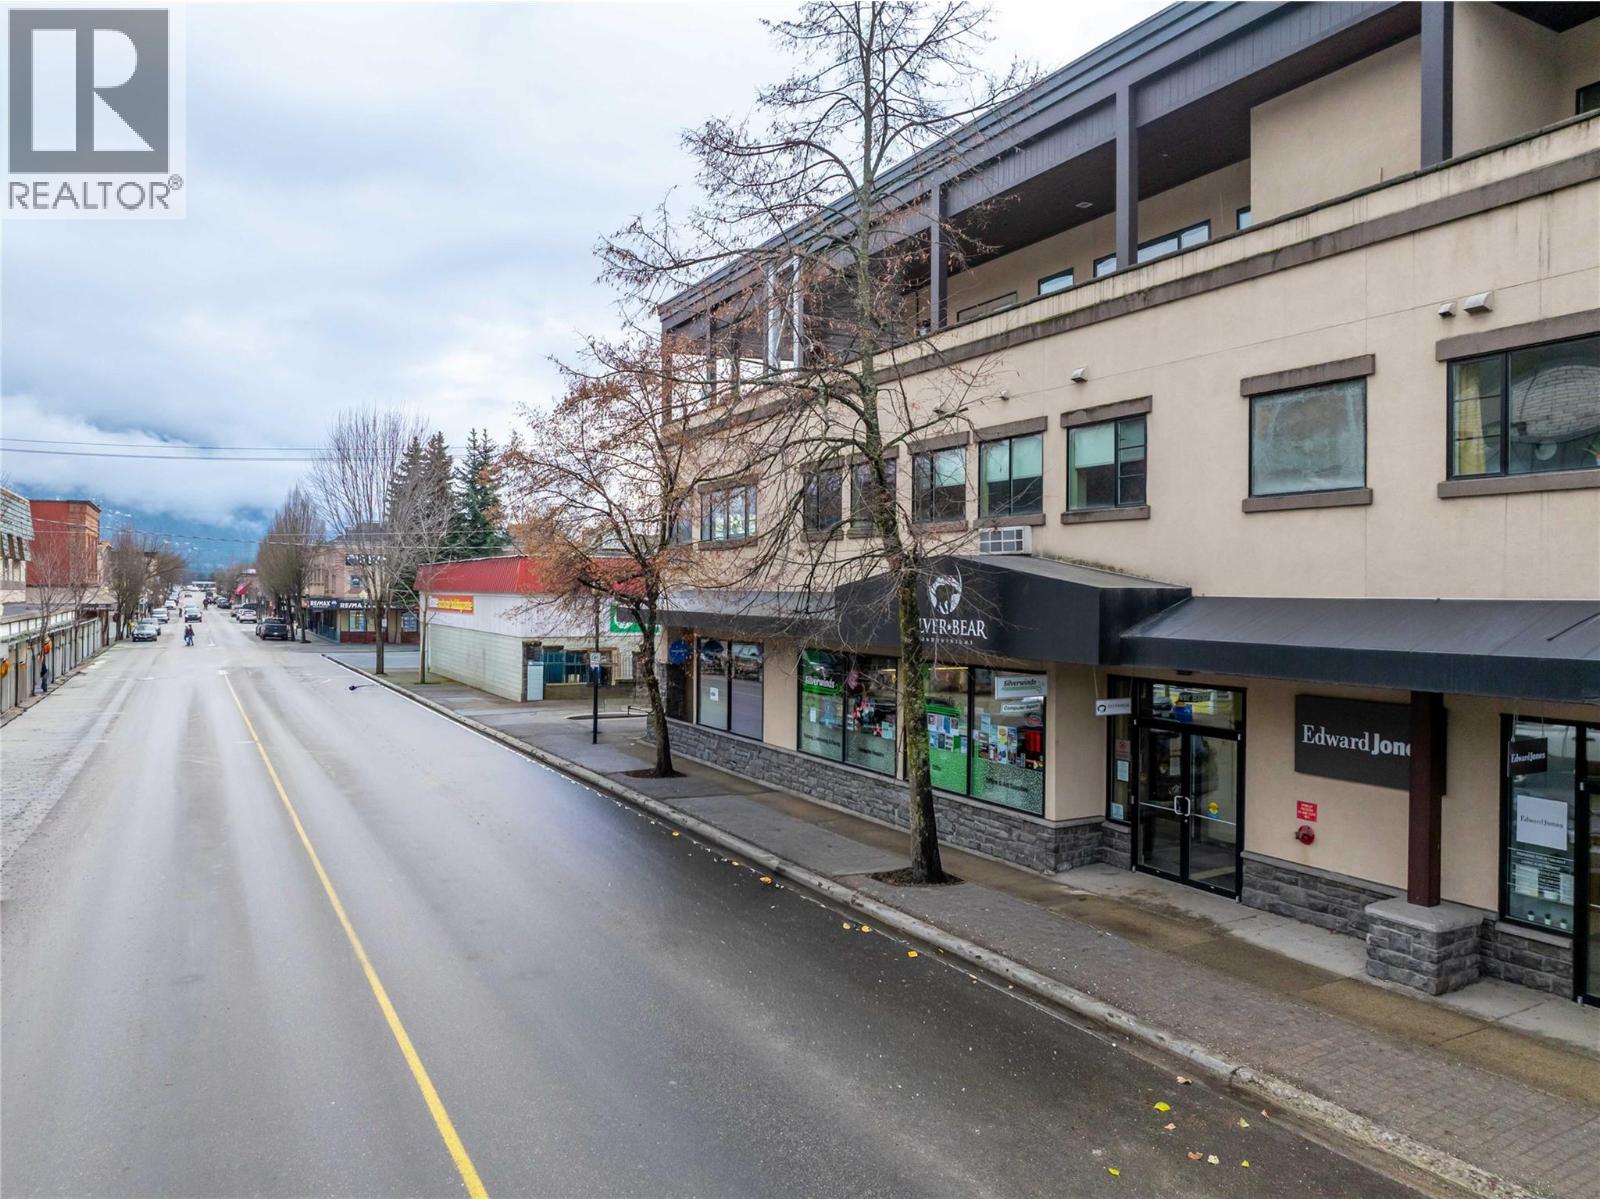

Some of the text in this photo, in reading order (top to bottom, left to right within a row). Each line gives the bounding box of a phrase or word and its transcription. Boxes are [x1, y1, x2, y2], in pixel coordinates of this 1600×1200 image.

[919, 617, 988, 640] LVER BEAR
[1301, 724, 1411, 757] Edward Jon
